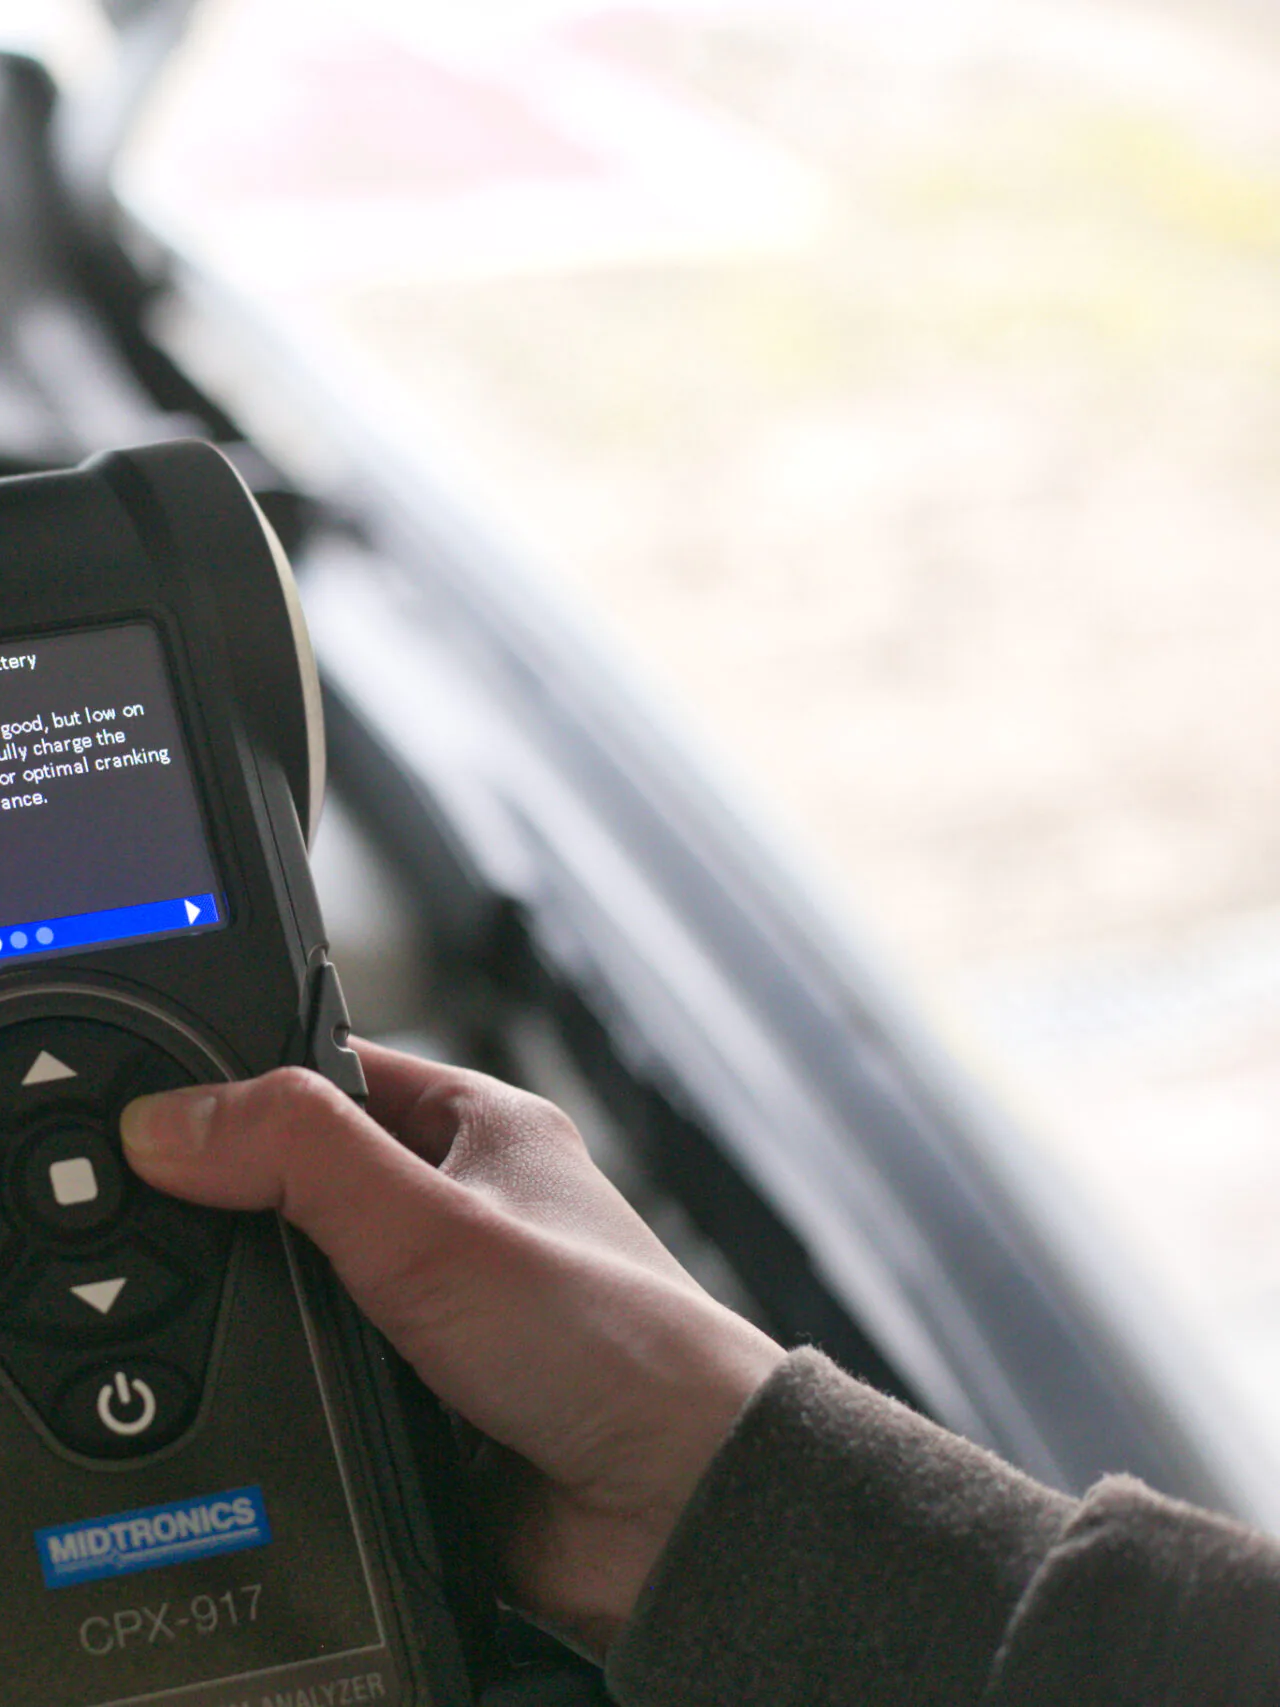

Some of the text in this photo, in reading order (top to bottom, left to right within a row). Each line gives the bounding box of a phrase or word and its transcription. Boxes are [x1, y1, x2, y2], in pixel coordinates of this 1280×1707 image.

[0, 713, 50, 741] good,
[51, 711, 82, 729] but
[84, 706, 116, 724] low
[122, 703, 145, 718] on
[32, 737, 93, 756] charge
[95, 728, 126, 746] the
[22, 755, 90, 785] optimal
[94, 747, 172, 771] cranking
[47, 1496, 256, 1564] MIDTRONICS
[79, 1584, 263, 1656] CPX-917
